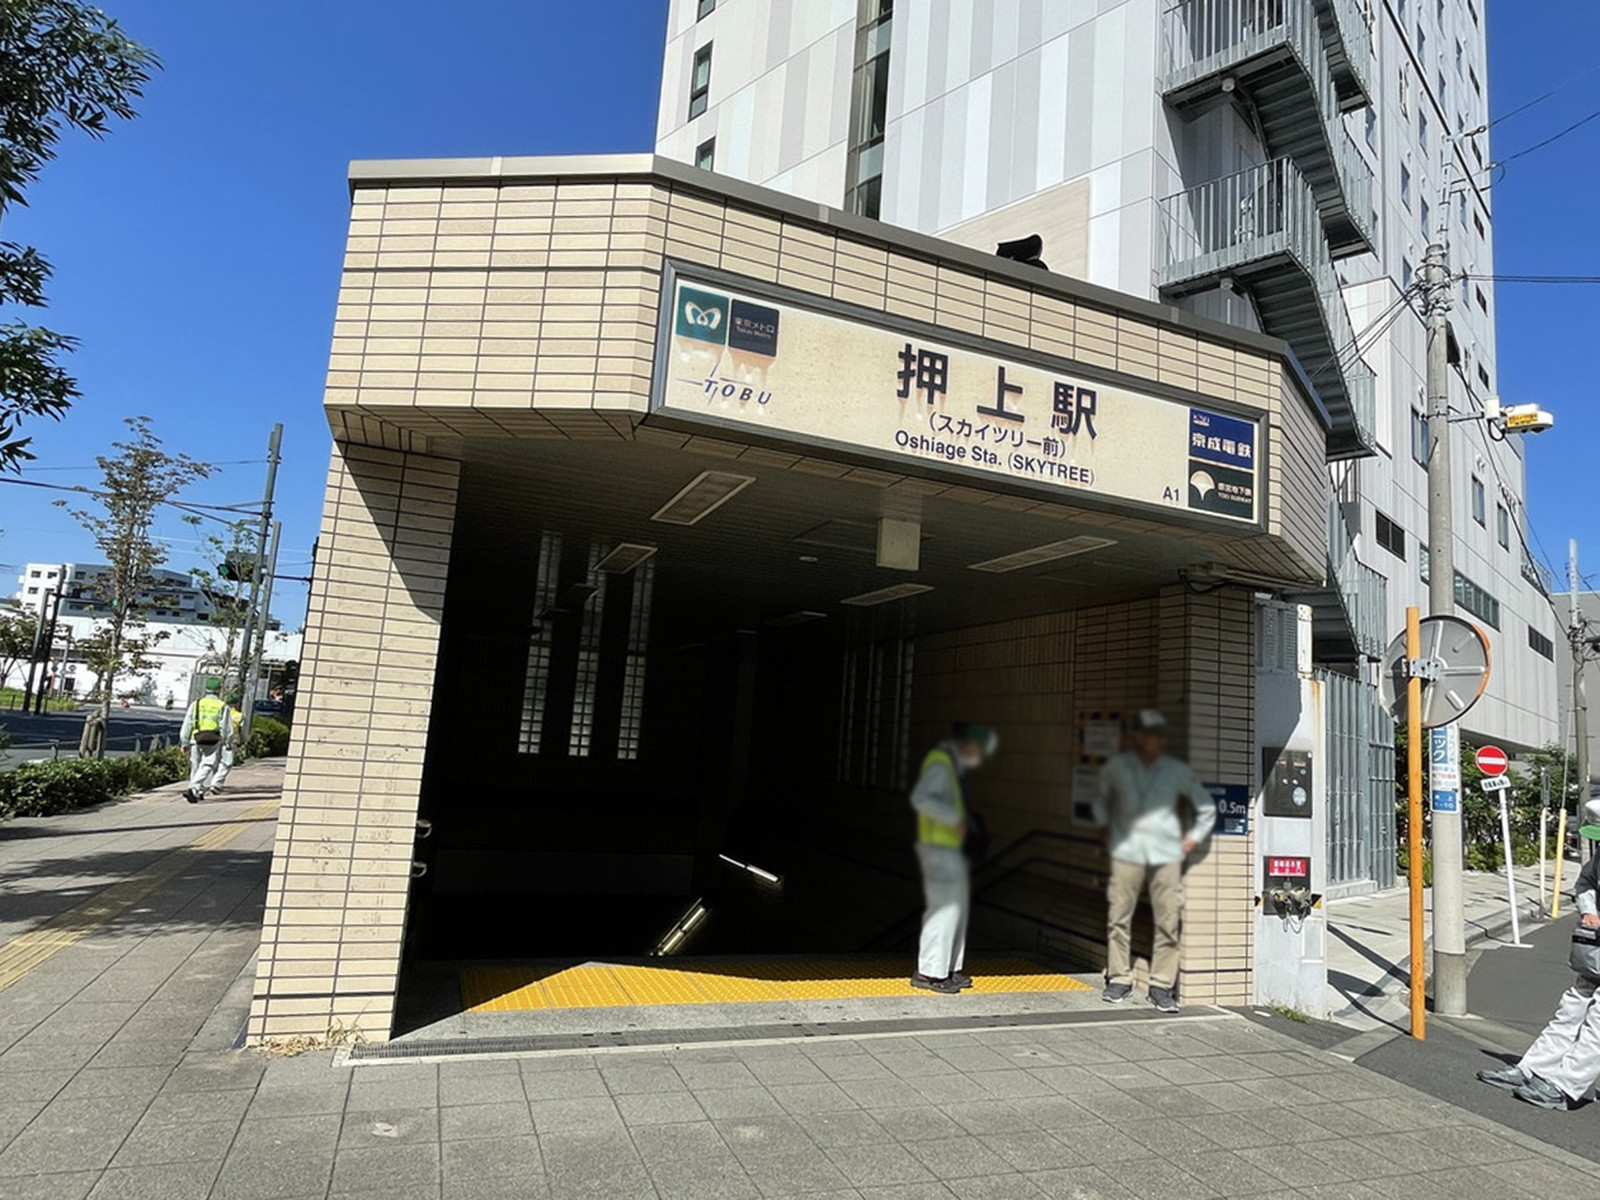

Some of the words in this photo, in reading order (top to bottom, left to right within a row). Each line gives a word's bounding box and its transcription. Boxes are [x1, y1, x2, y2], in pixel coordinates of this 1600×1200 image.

[703, 378, 772, 406] TOBU
[896, 342, 1098, 441] 押上駅
[929, 411, 1066, 459] （スカイツリー前）
[1192, 432, 1251, 458] 京成電鉄
[895, 429, 967, 460] Oshiage
[971, 445, 1002, 466] Sta.
[1007, 453, 1095, 487] (SKYTREE)
[1163, 486, 1179, 502] A1
